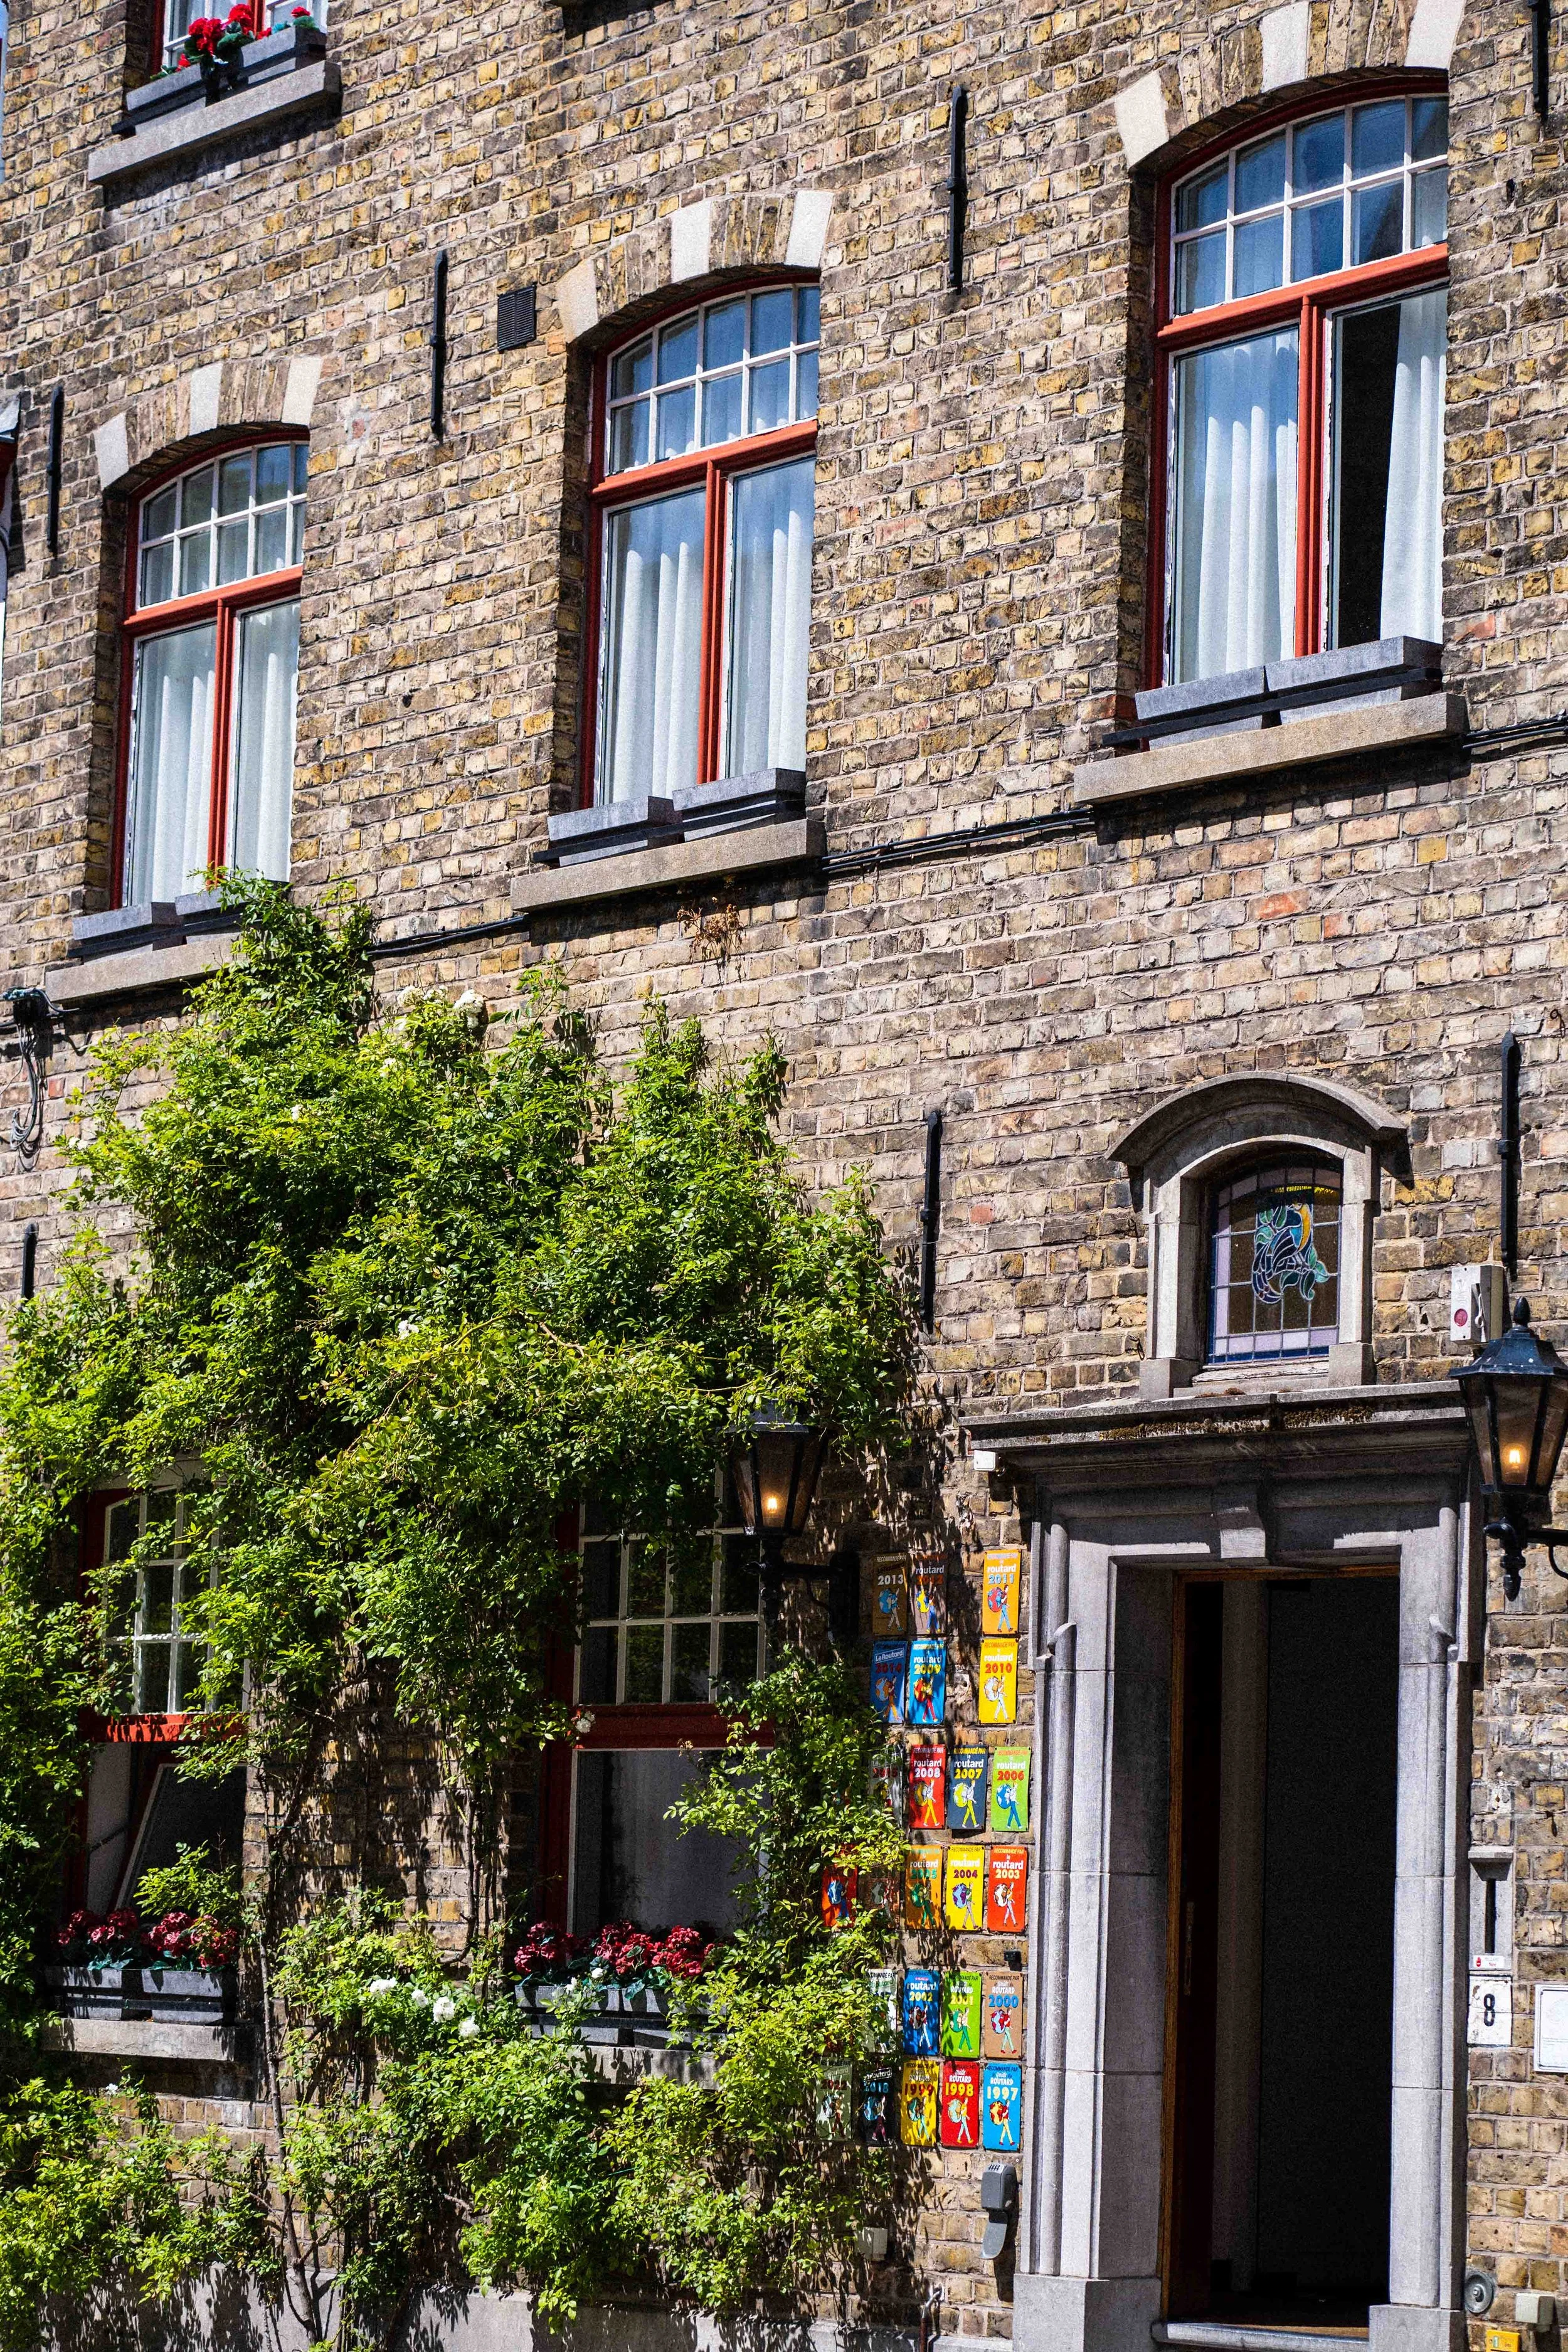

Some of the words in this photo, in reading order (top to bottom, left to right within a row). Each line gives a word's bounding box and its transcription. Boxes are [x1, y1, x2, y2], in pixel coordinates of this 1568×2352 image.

[916, 1565, 945, 1574] routard
[987, 1564, 1017, 1573] routard
[877, 1574, 904, 1586] 2013
[988, 1574, 1014, 1584] 2011
[882, 1650, 903, 1660] Routard
[913, 1655, 942, 1663] routard
[984, 1653, 1014, 1662] routard
[876, 1663, 902, 1675] 2014
[914, 1663, 941, 1675] 2009
[985, 1663, 1012, 1673] 2010
[914, 1758, 942, 1767] routard
[954, 1759, 984, 1768] routard
[997, 1761, 1026, 1769] routard
[914, 1767, 941, 1778] 2008
[954, 1768, 983, 1779] 2007
[997, 1770, 1025, 1781] 2006
[910, 1859, 939, 1868] routard
[950, 1858, 980, 1867] routard
[993, 1860, 1024, 1870] routard
[911, 1868, 938, 1880] 2005
[953, 1869, 978, 1878] 2004
[995, 1868, 1020, 1880] 2003
[906, 1981, 936, 1991] routard
[950, 1986, 973, 1994] ROUTARD
[992, 1986, 1015, 1994] ROUTARD
[909, 1991, 933, 2002] 2002
[950, 1993, 973, 2005] 2001
[988, 1994, 1019, 2008] 2000
[1483, 1993, 1496, 2026] 8
[909, 2074, 931, 2082] ROUTARD
[949, 2075, 972, 2083] ROUTARD
[990, 2077, 1014, 2085] ROUTARD
[904, 2082, 934, 2096] 1999
[945, 2082, 973, 2097] 1998
[987, 2086, 1019, 2101] 1997
